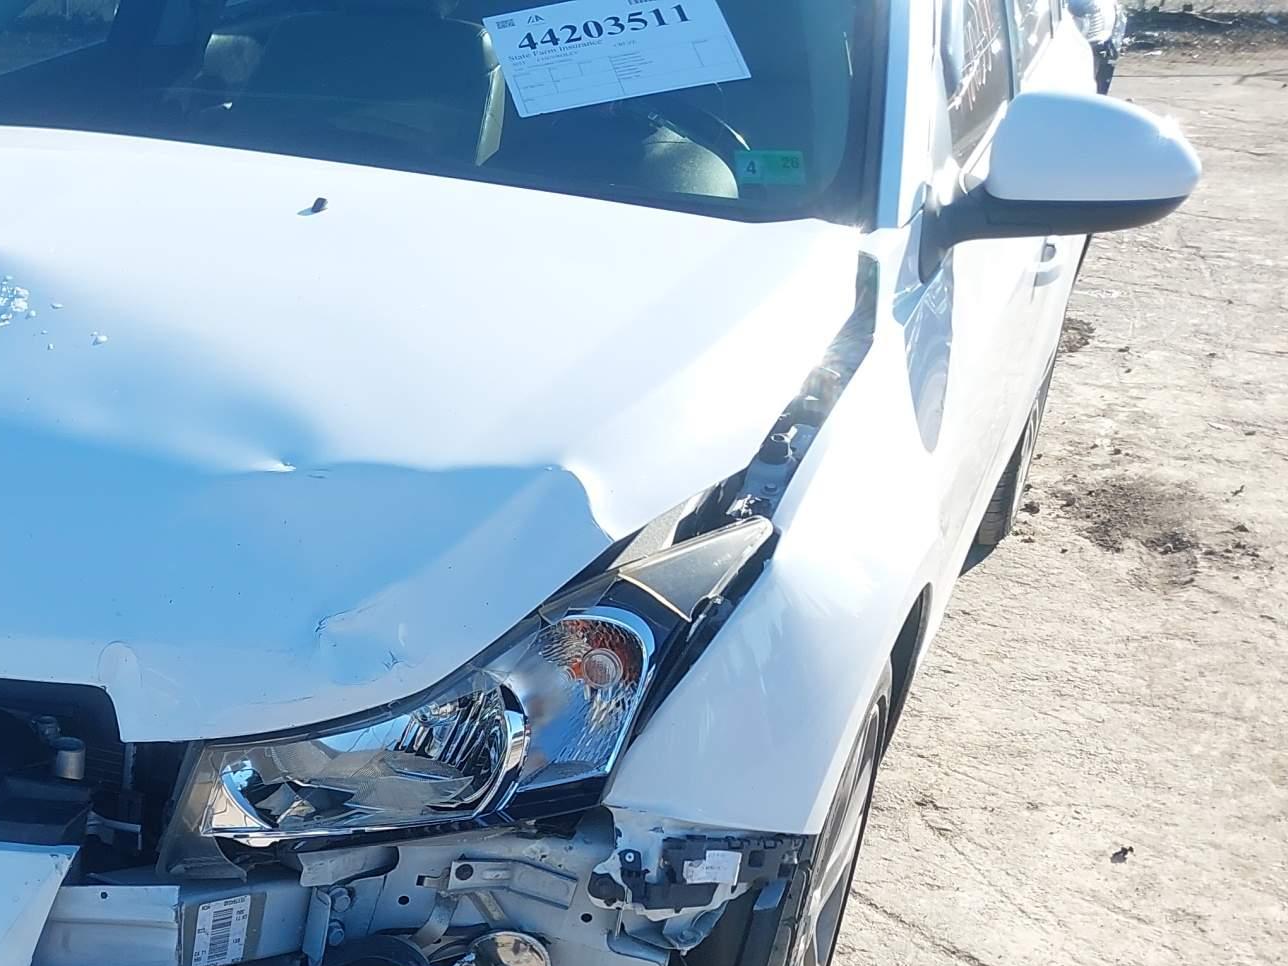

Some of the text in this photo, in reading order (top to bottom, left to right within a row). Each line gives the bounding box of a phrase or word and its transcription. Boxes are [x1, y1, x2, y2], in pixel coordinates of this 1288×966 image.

[518, 4, 691, 50] 44203511
[508, 53, 531, 62] State
[533, 47, 557, 57] Farm
[559, 39, 603, 52] Insurance
[746, 160, 757, 174] 4
